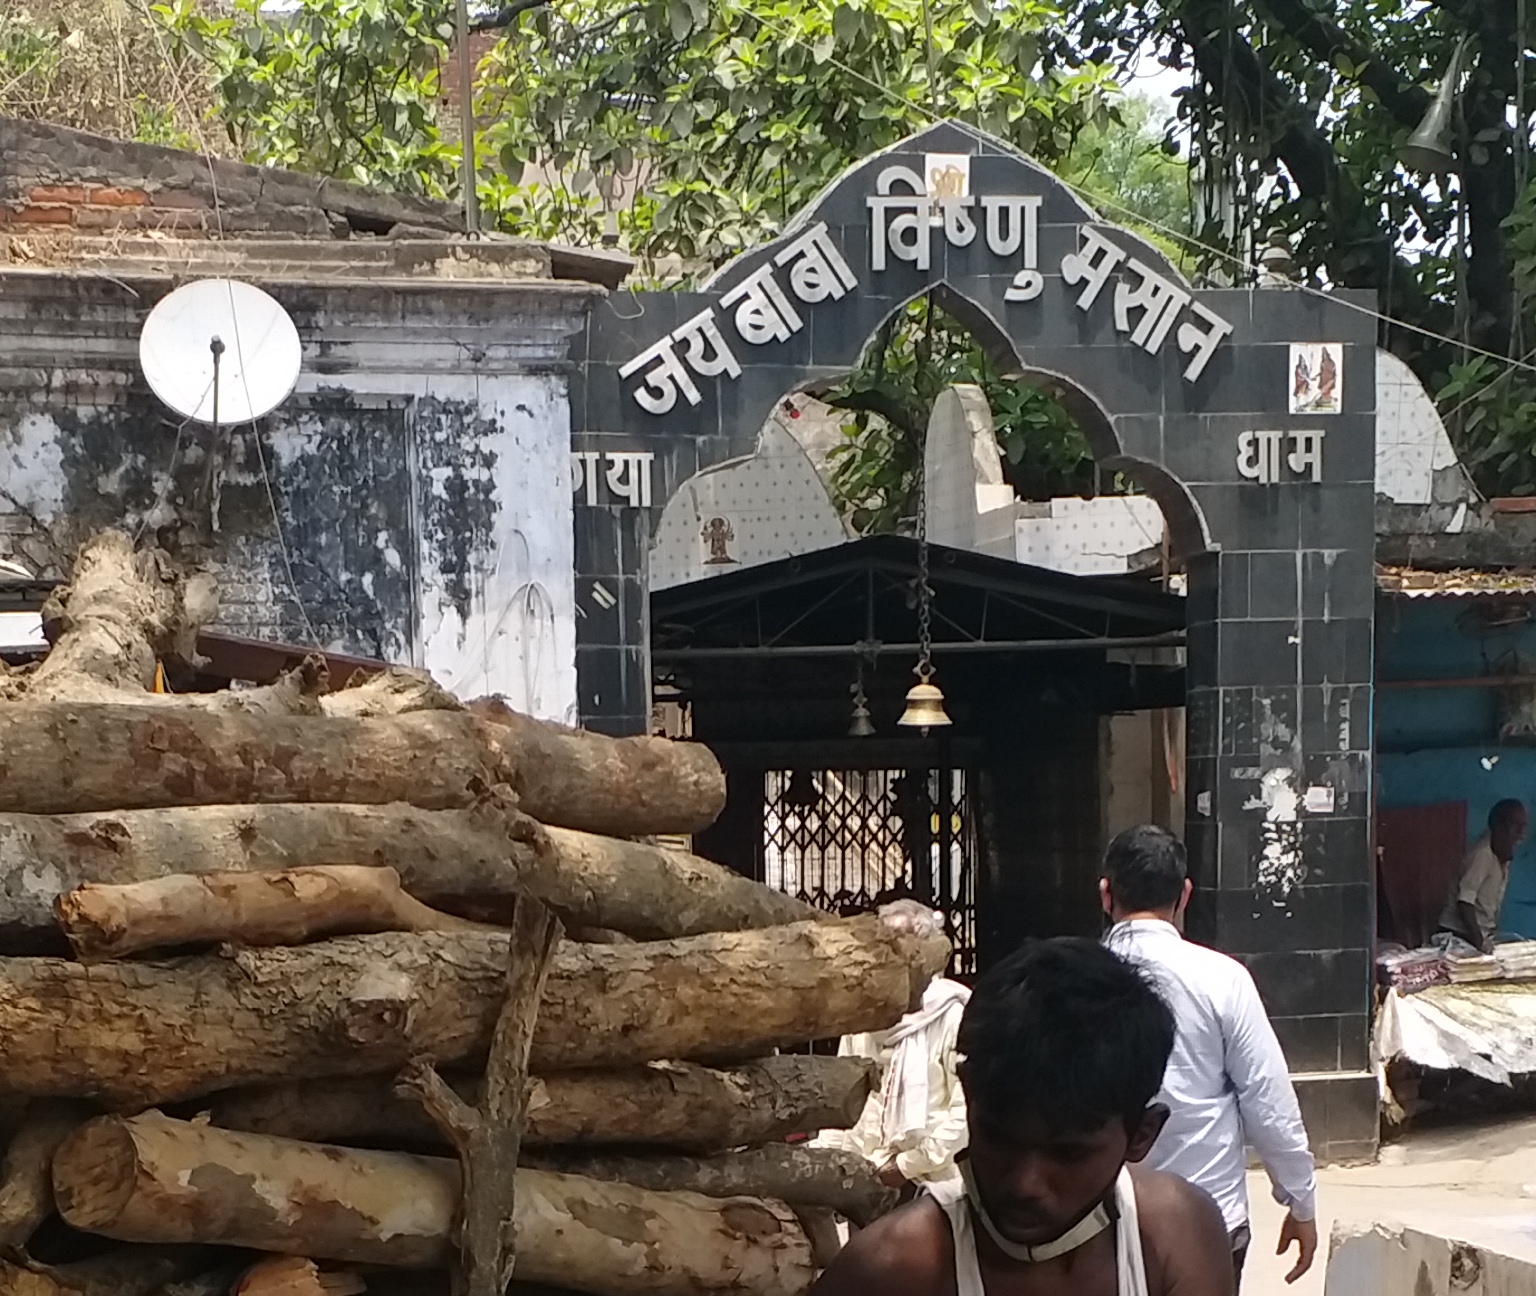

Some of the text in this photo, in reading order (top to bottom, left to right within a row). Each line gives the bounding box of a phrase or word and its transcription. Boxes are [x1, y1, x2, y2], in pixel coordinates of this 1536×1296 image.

[618, 165, 1234, 415] जय बाबा विष्णु मसान
[1236, 429, 1326, 484] धाम
